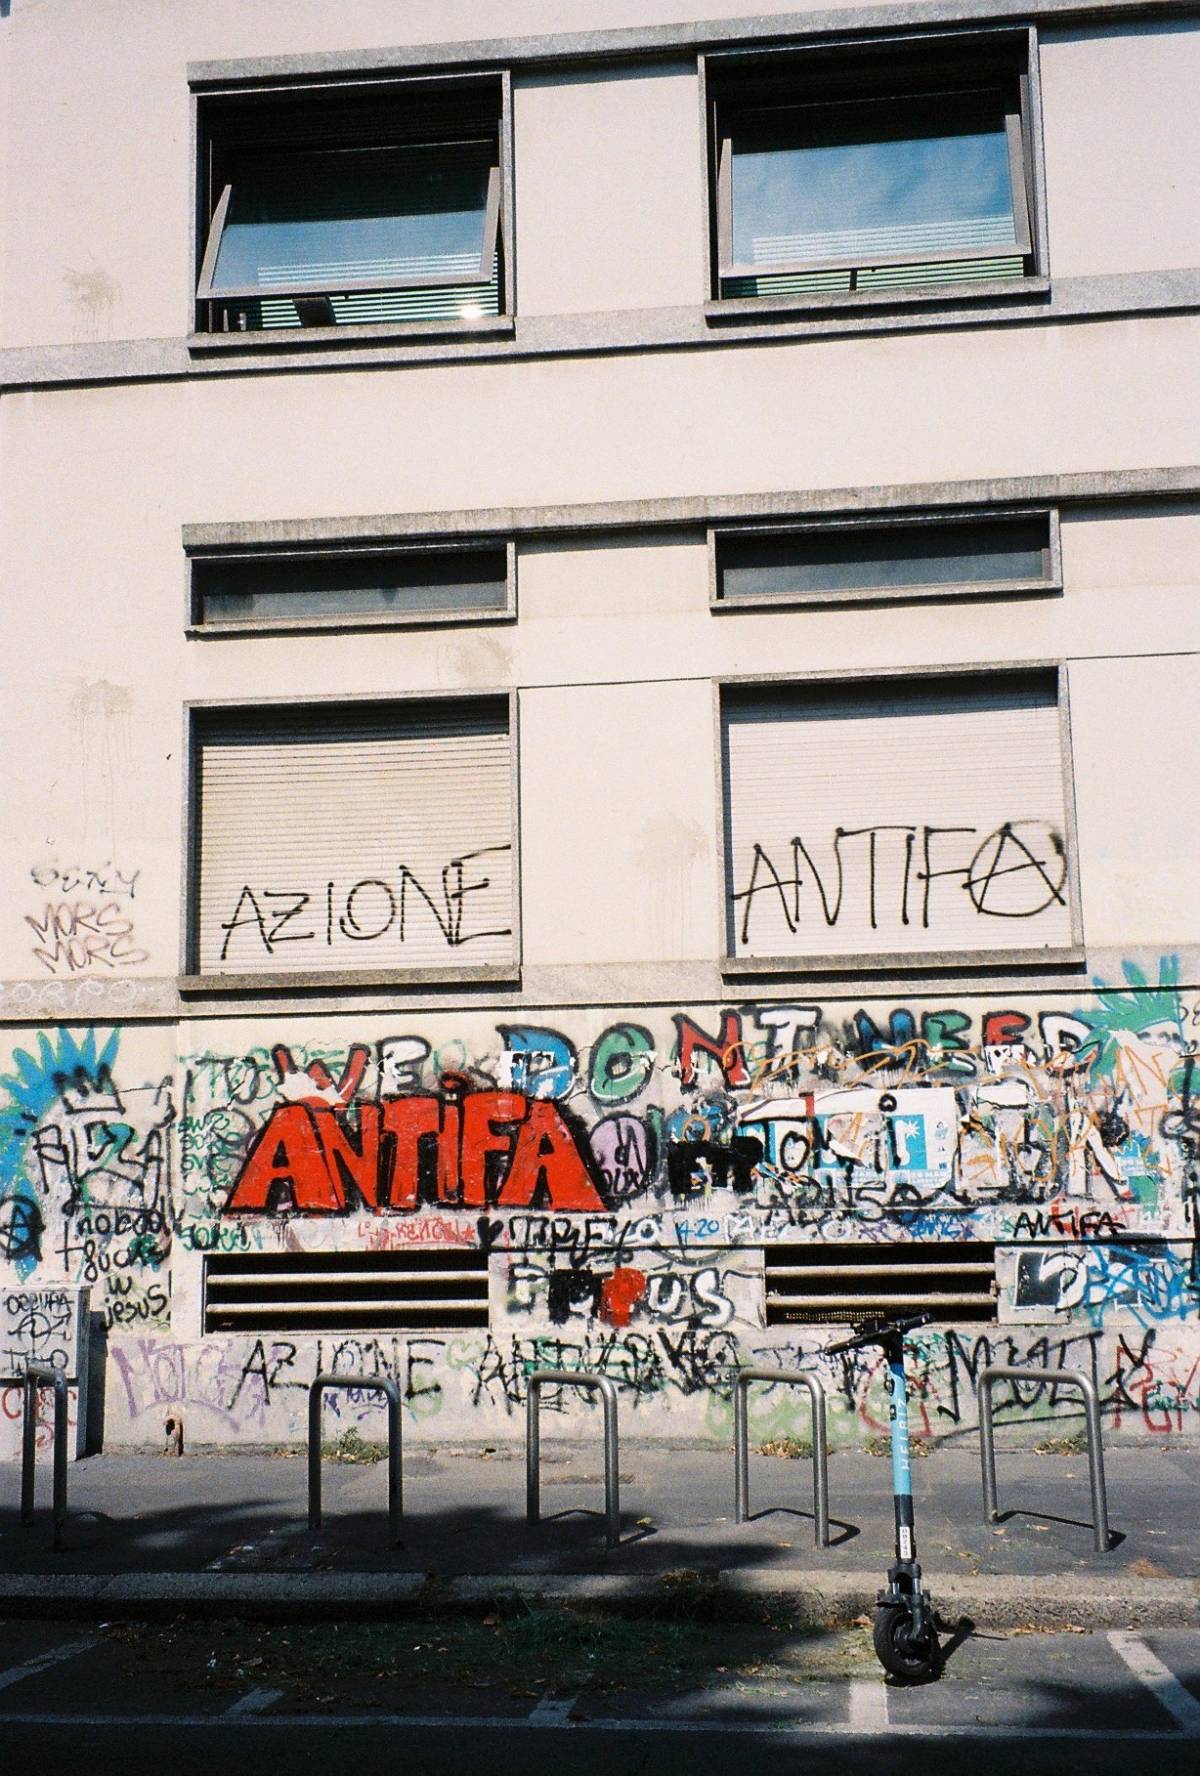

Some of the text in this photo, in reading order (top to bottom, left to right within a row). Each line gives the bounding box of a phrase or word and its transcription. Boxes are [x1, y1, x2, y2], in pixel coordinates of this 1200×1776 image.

[221, 844, 512, 960] AZIONE
[732, 821, 1068, 944] ANTIFA
[223, 1073, 608, 1215] ANTIFA
